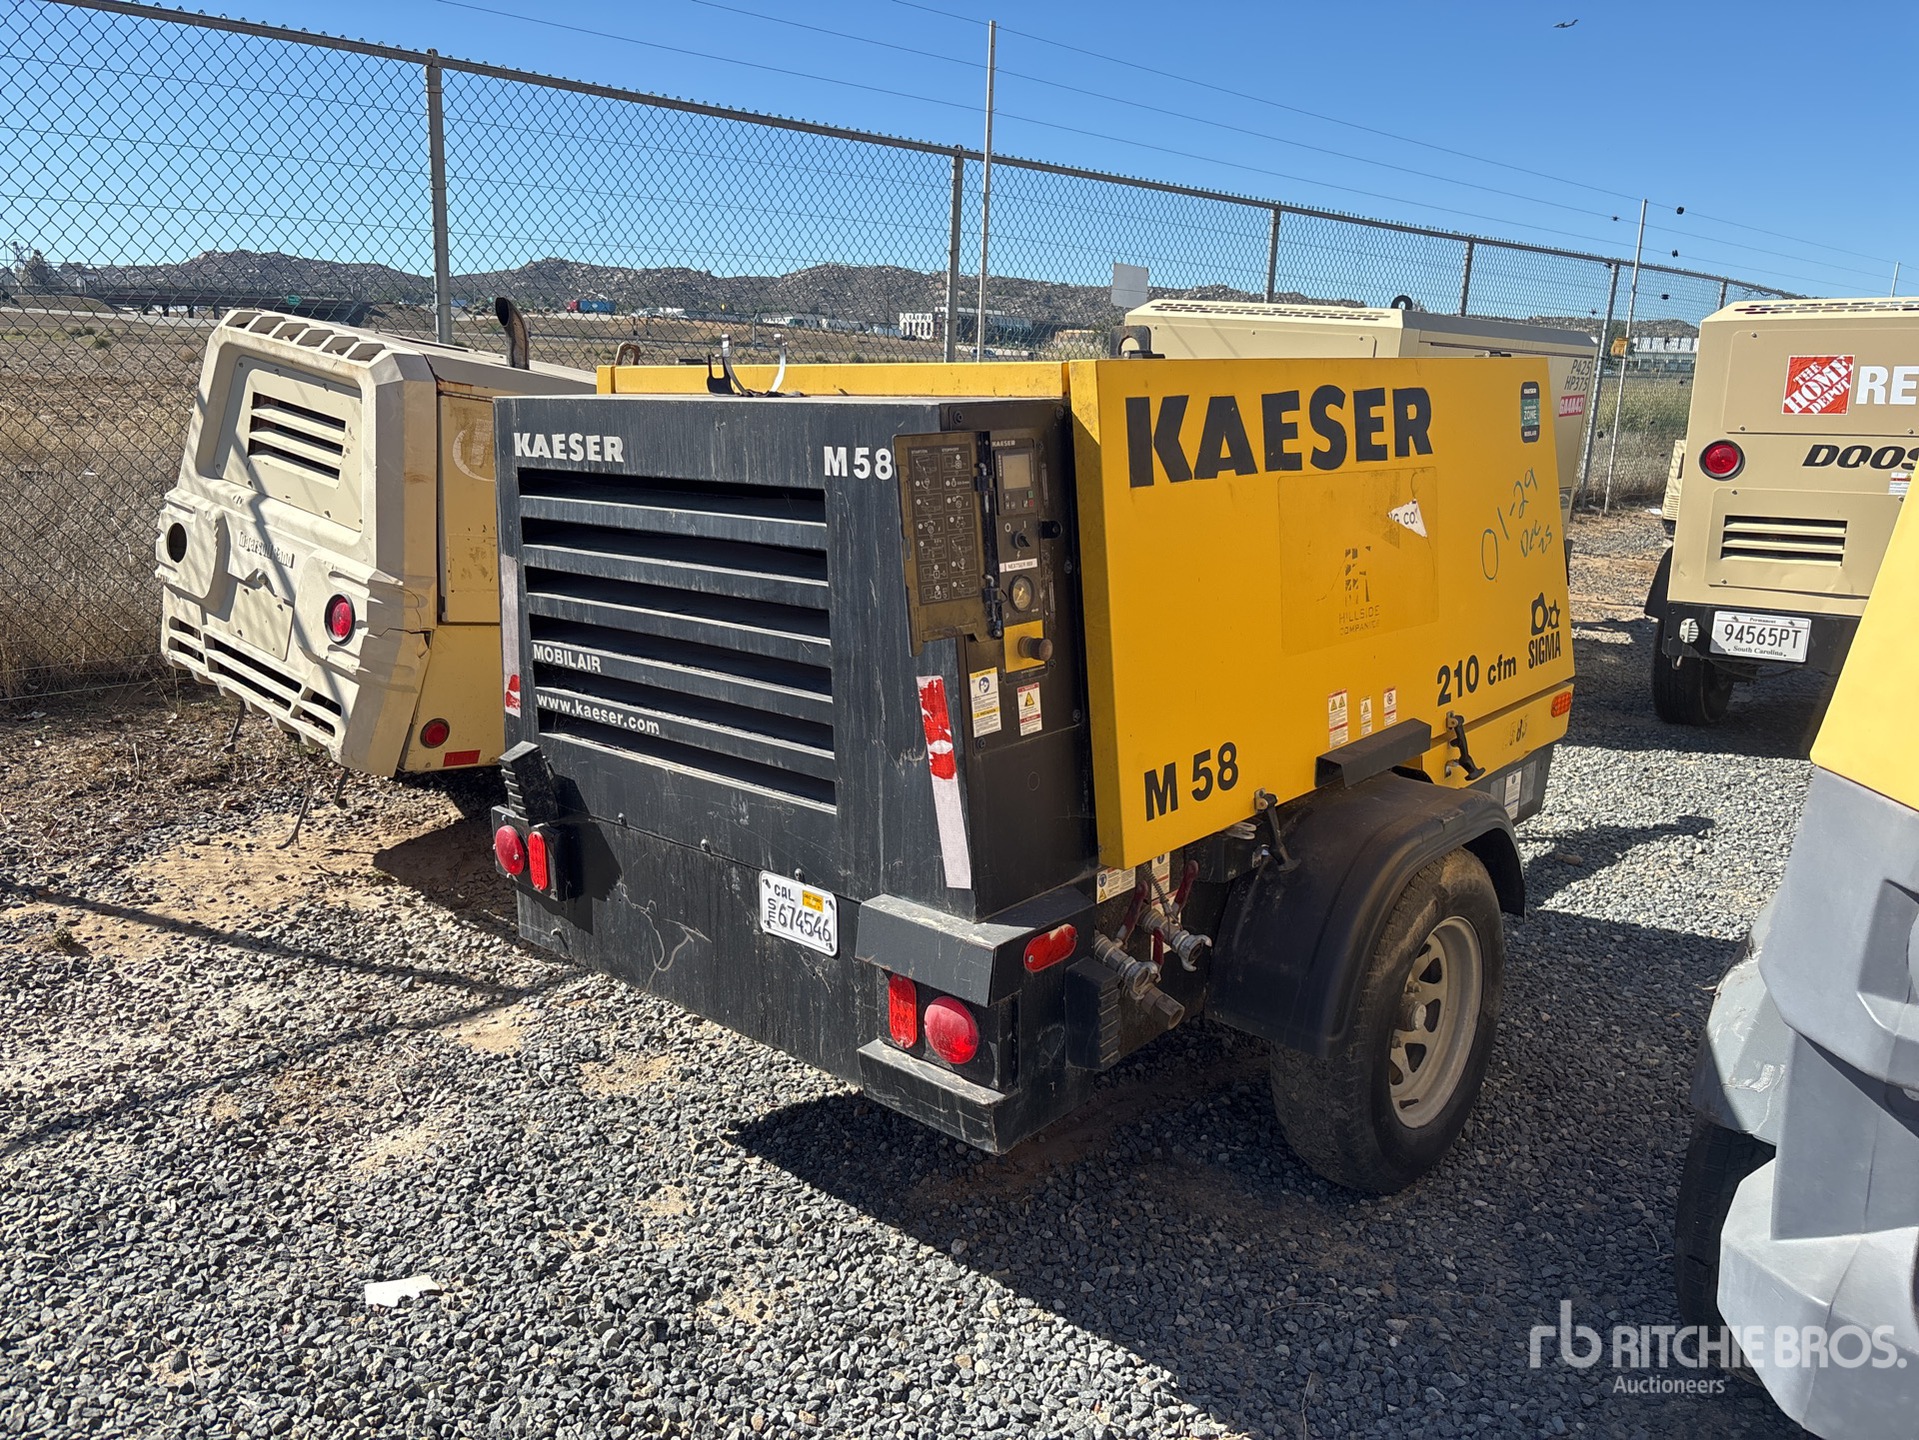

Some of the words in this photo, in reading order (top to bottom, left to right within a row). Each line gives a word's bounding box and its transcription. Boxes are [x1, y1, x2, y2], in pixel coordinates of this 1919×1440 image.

[1564, 375, 1589, 391] HP375
[1570, 359, 1591, 376] P425
[1783, 355, 1853, 414] HOME
[1793, 361, 1822, 386] THE
[1808, 377, 1850, 414] DEPOT
[513, 432, 624, 463] KAESER
[1125, 384, 1433, 488] KAESER
[1528, 631, 1561, 670] SIGMA
[1724, 623, 1802, 649] 94565PT
[1733, 645, 1753, 654] South
[1754, 647, 1784, 656] Carolina
[533, 644, 602, 673] MOBILAIR
[1436, 654, 1480, 707] 210
[1487, 654, 1517, 686] cfm
[536, 693, 660, 735] www.kaeser.com
[1143, 761, 1179, 822] M
[1191, 741, 1239, 802] 58
[774, 883, 795, 902] CAL
[778, 903, 832, 942] 674546
